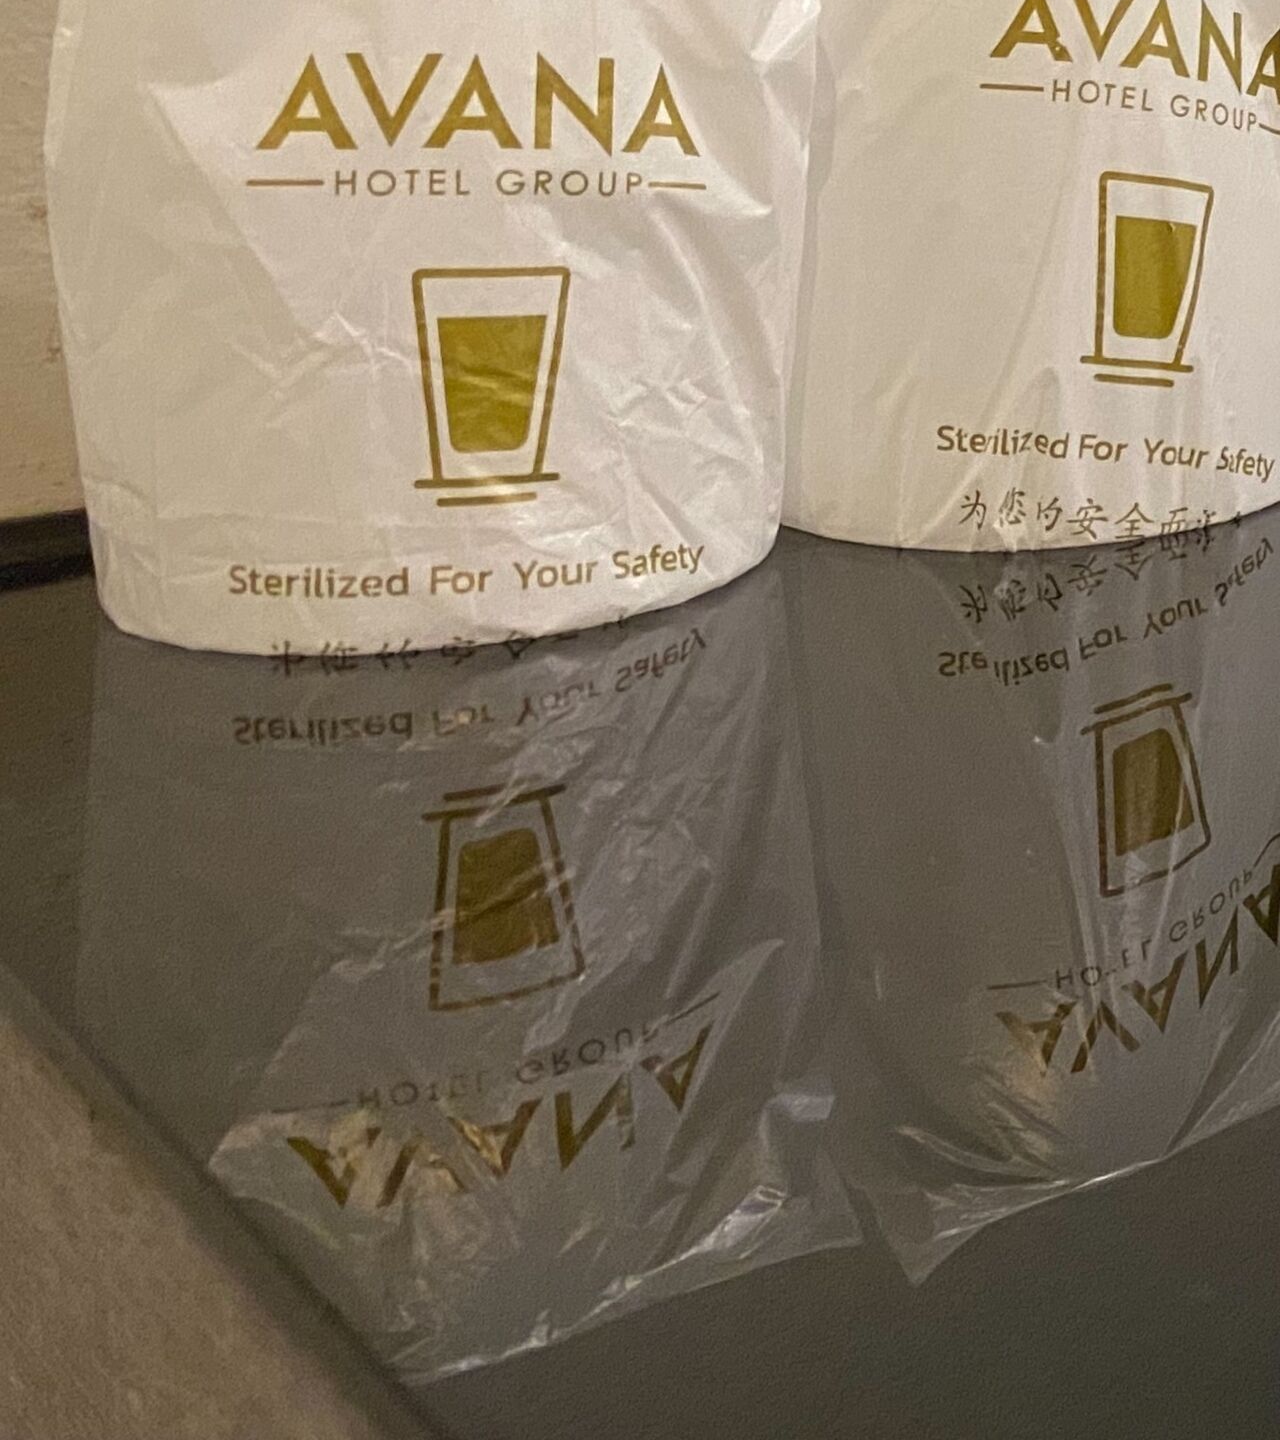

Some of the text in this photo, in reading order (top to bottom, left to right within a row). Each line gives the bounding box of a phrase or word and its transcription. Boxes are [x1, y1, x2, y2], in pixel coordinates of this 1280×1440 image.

[256, 51, 700, 157] AVANA
[1052, 79, 1257, 132] HOTEL GROUP
[334, 169, 643, 197] HOTEL GROUP
[1079, 434, 1128, 462] For
[1144, 438, 1209, 470] Your
[229, 543, 706, 599] Sterilized For Your Safety
